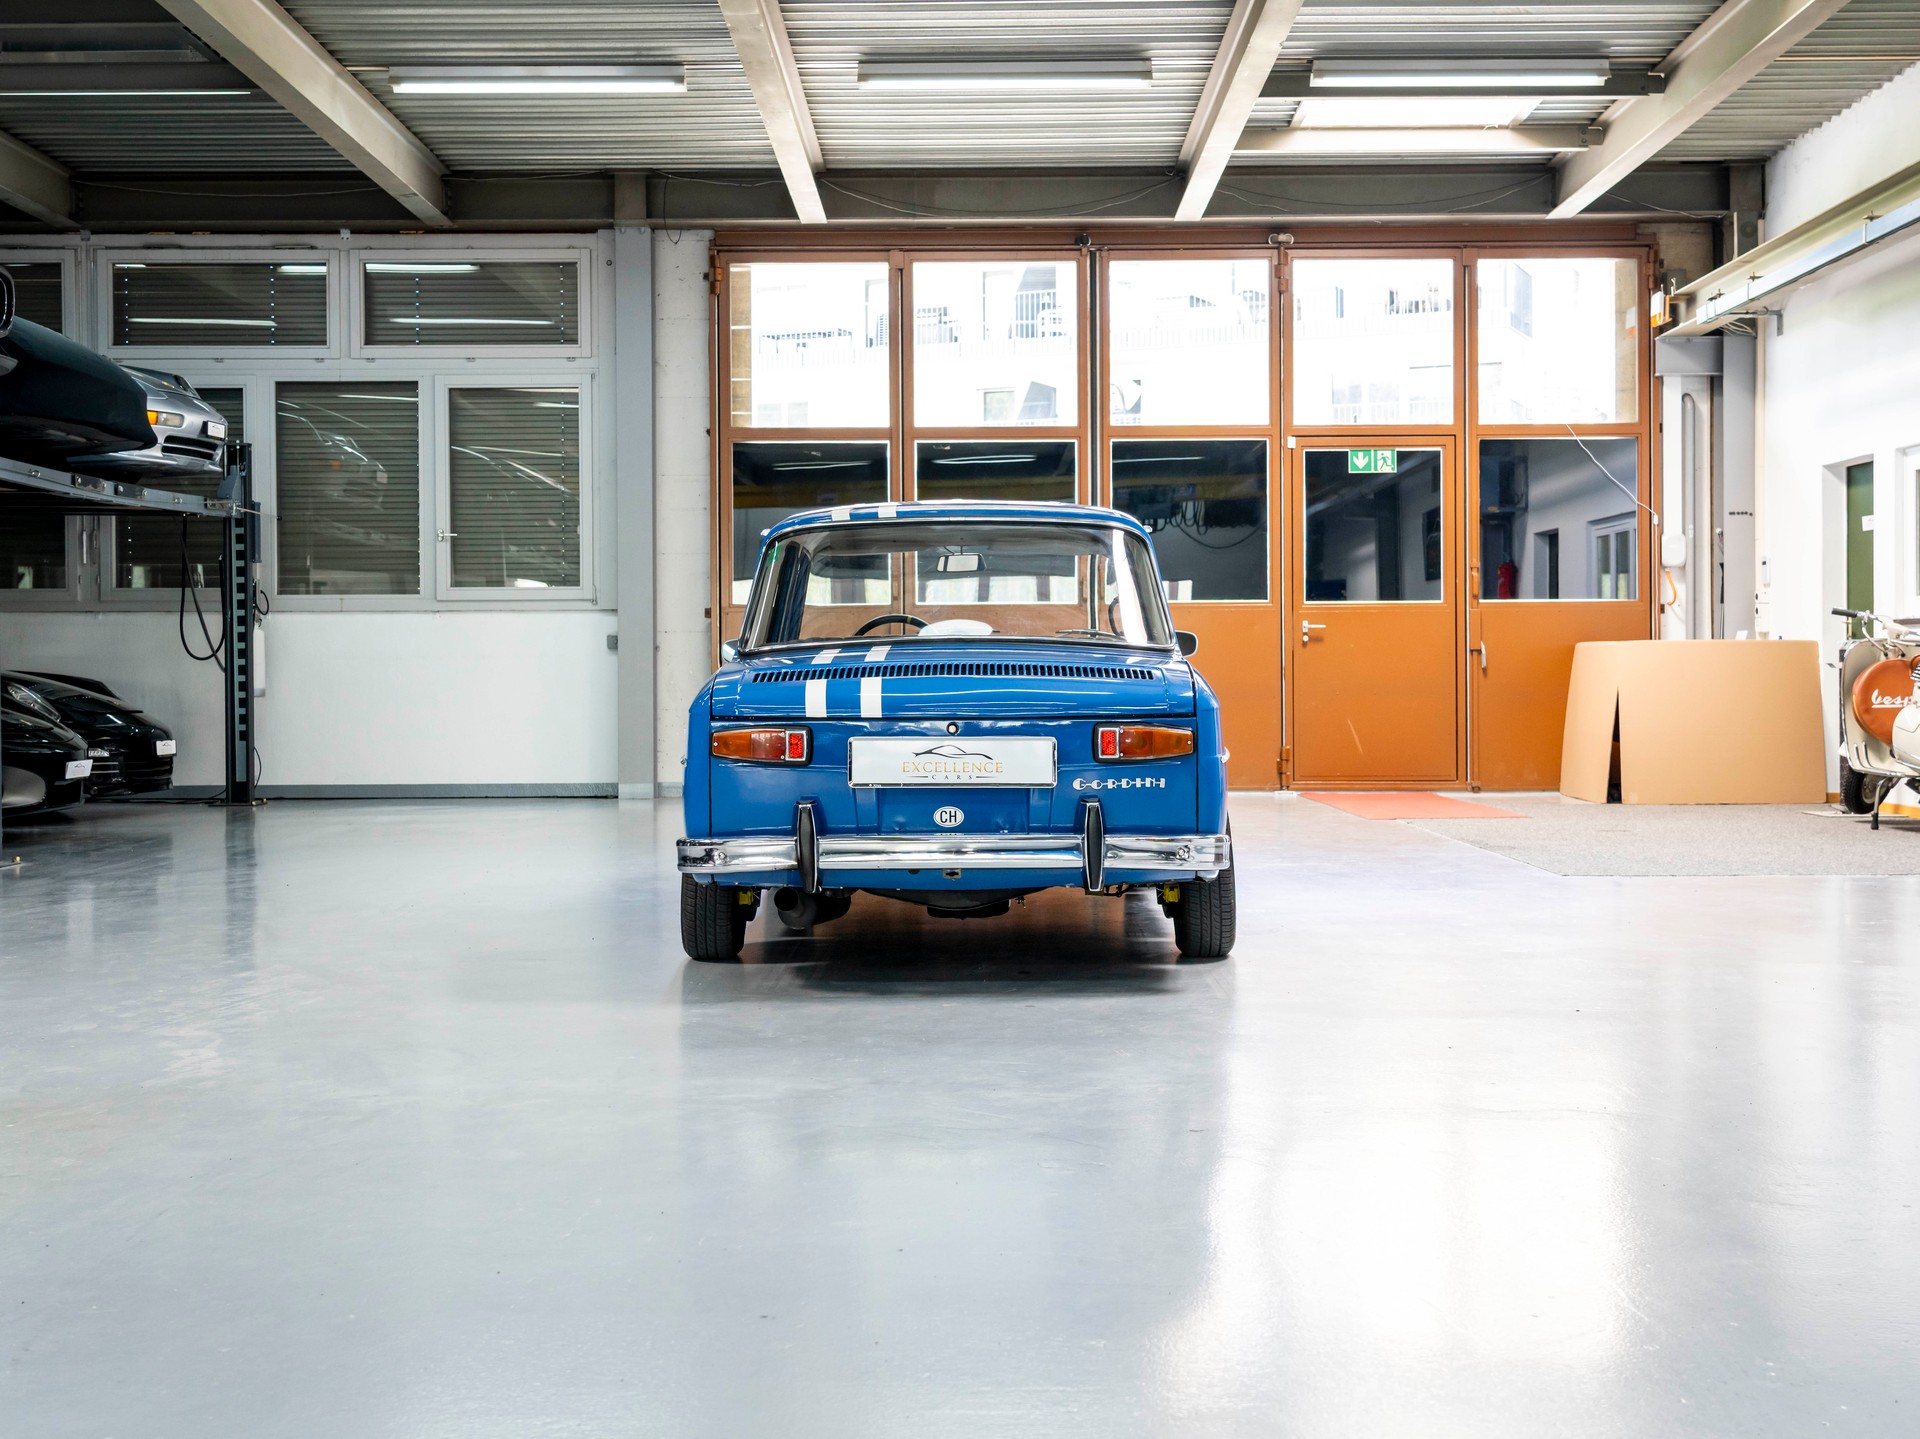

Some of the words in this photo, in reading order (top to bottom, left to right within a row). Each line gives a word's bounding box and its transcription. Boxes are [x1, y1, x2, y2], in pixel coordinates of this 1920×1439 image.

[1871, 688, 1914, 708] Vesp
[902, 761, 1004, 773] EXCELLENCE
[1072, 777, 1166, 791] GORDINI
[940, 810, 957, 823] CH
